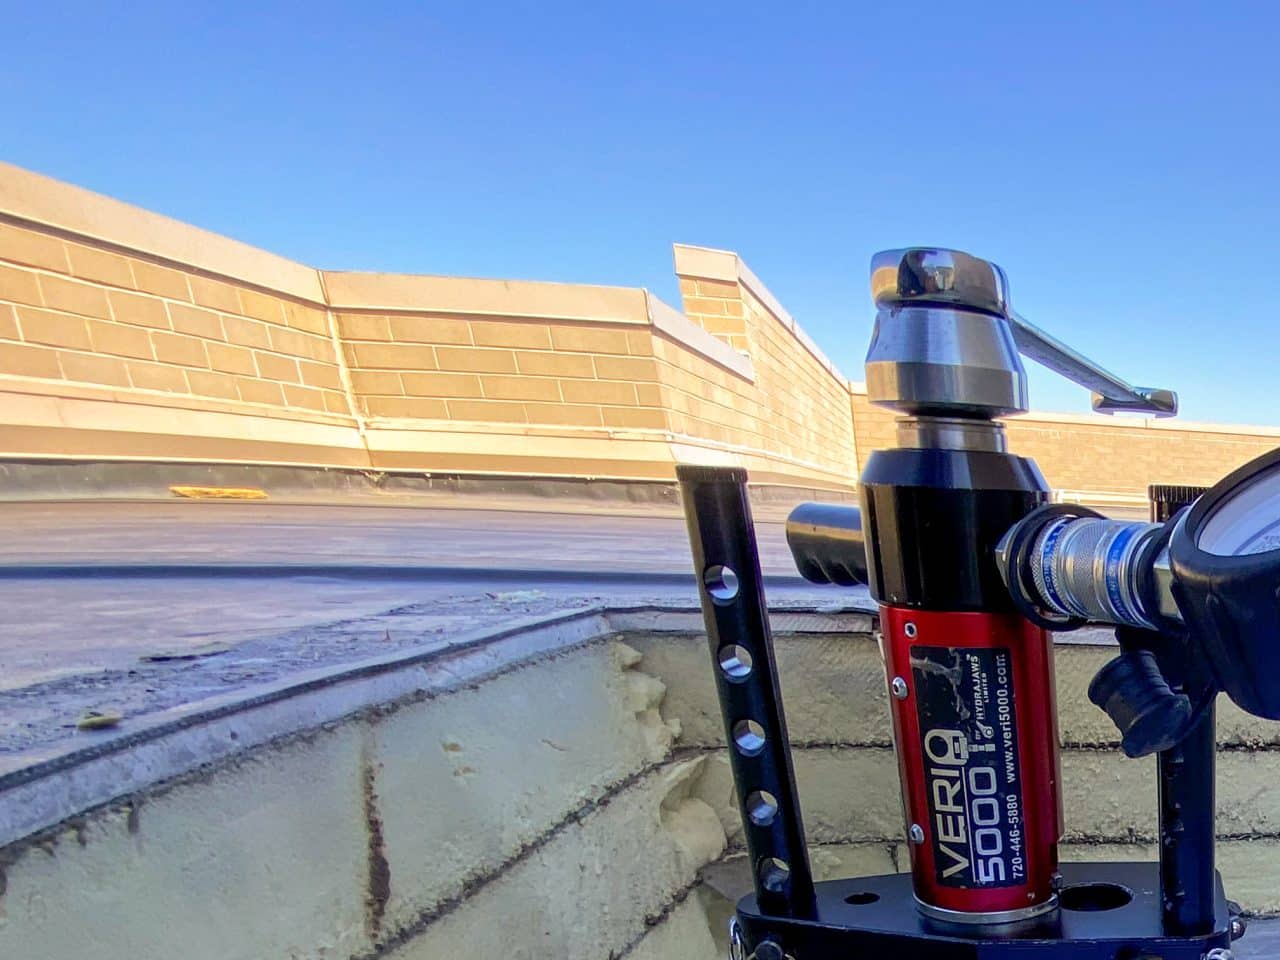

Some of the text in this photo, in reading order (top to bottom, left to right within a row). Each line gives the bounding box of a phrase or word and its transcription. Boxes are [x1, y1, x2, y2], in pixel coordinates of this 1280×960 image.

[970, 655, 985, 720] HYDRAJAWS
[930, 767, 970, 878] VERI
[996, 653, 1024, 879] 720-446-5880 www.veri5000.com
[968, 766, 1006, 882] 5000
